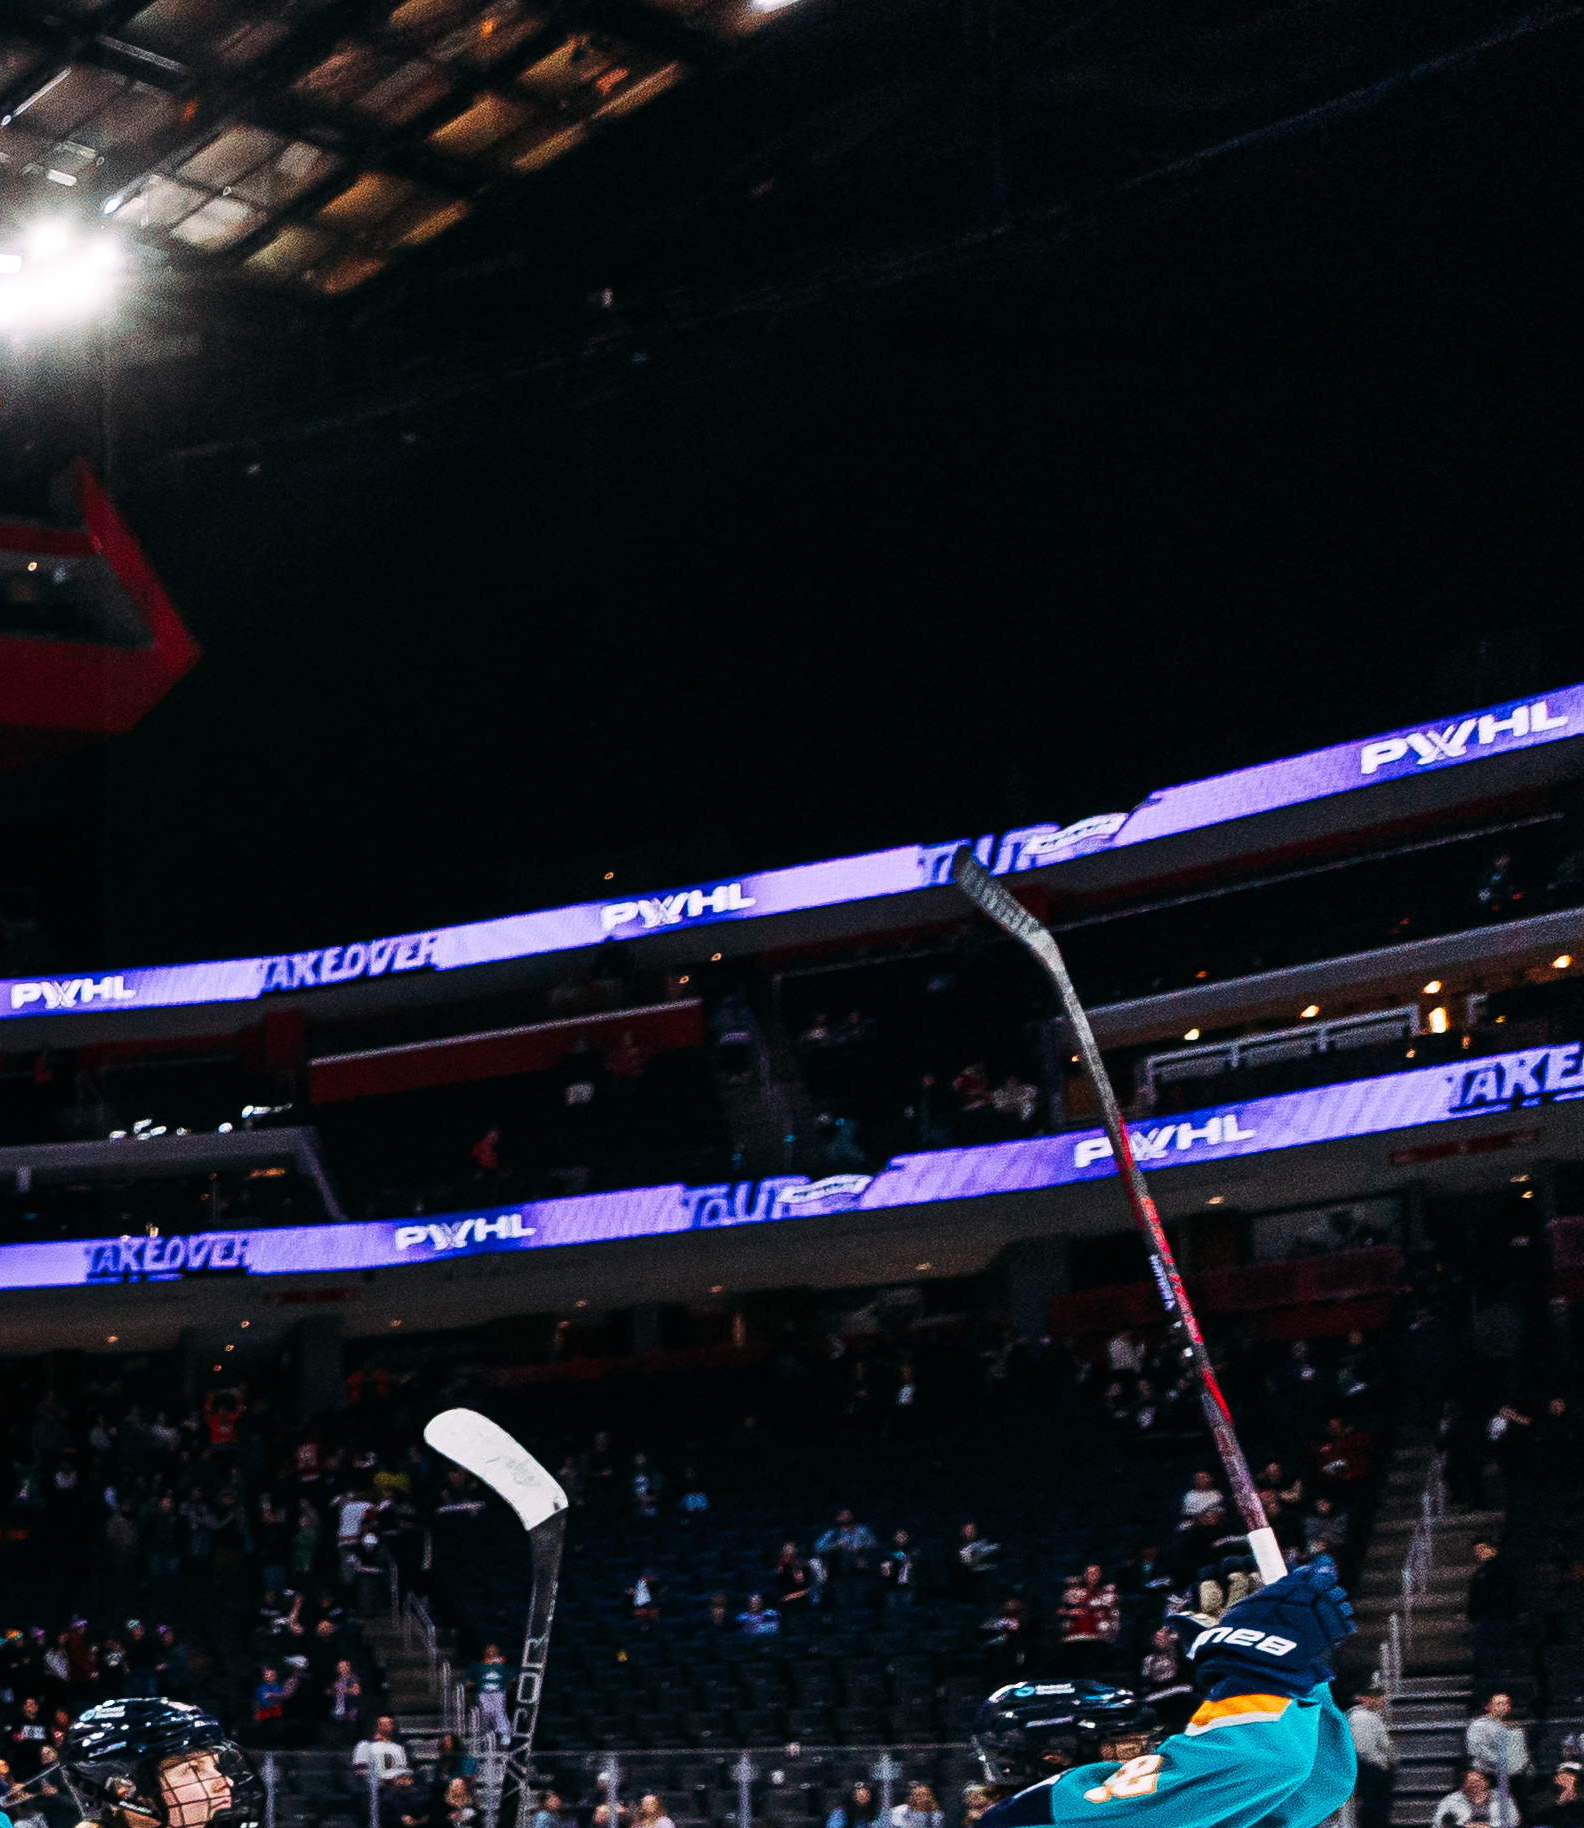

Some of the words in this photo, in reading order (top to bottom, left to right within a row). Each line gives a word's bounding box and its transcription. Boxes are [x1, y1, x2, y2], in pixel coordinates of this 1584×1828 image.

[1359, 700, 1568, 777] PWHL
[599, 883, 757, 933] PWHL
[10, 976, 137, 1009] PWHL
[393, 1214, 536, 1252] PWHL
